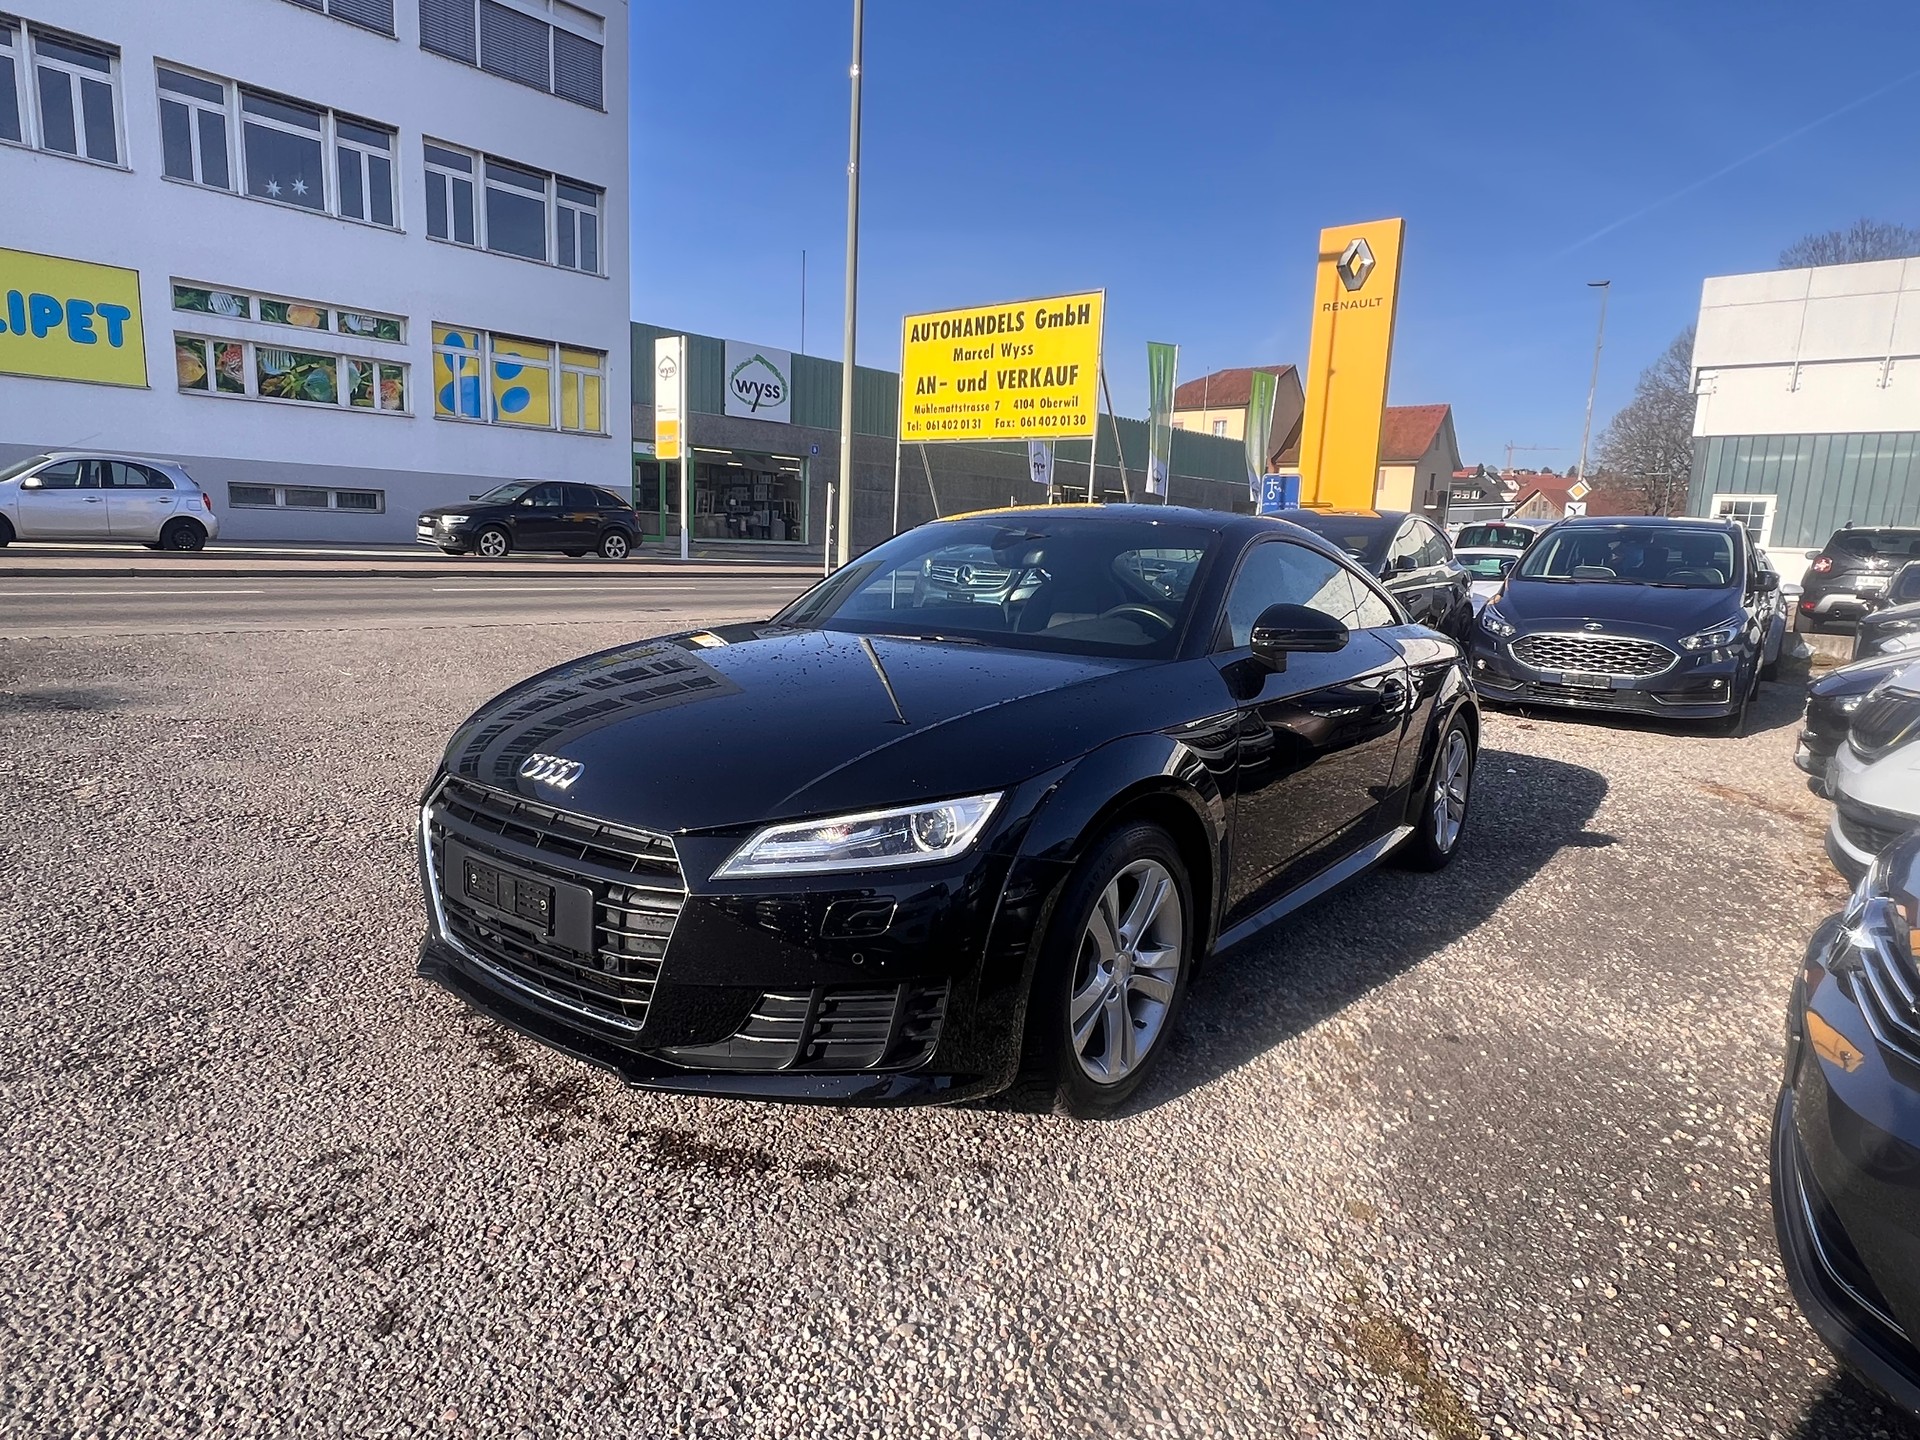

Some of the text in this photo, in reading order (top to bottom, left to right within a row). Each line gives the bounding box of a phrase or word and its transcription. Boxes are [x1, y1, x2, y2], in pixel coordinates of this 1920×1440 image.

[1323, 297, 1383, 311] RENAULT
[0, 289, 131, 348] IPET
[911, 303, 1090, 343] AUTOHANDELS GmbH
[953, 342, 1034, 361] Marcel Wyss
[660, 366, 675, 381] wyss
[916, 365, 1079, 395] AN- und VERKAUF
[735, 379, 780, 412] wyss
[994, 400, 1000, 411] 7
[1013, 398, 1034, 409] 4104
[1040, 395, 1078, 408] Oberwil
[907, 421, 921, 431] Tel:
[995, 418, 1015, 428] Fax:
